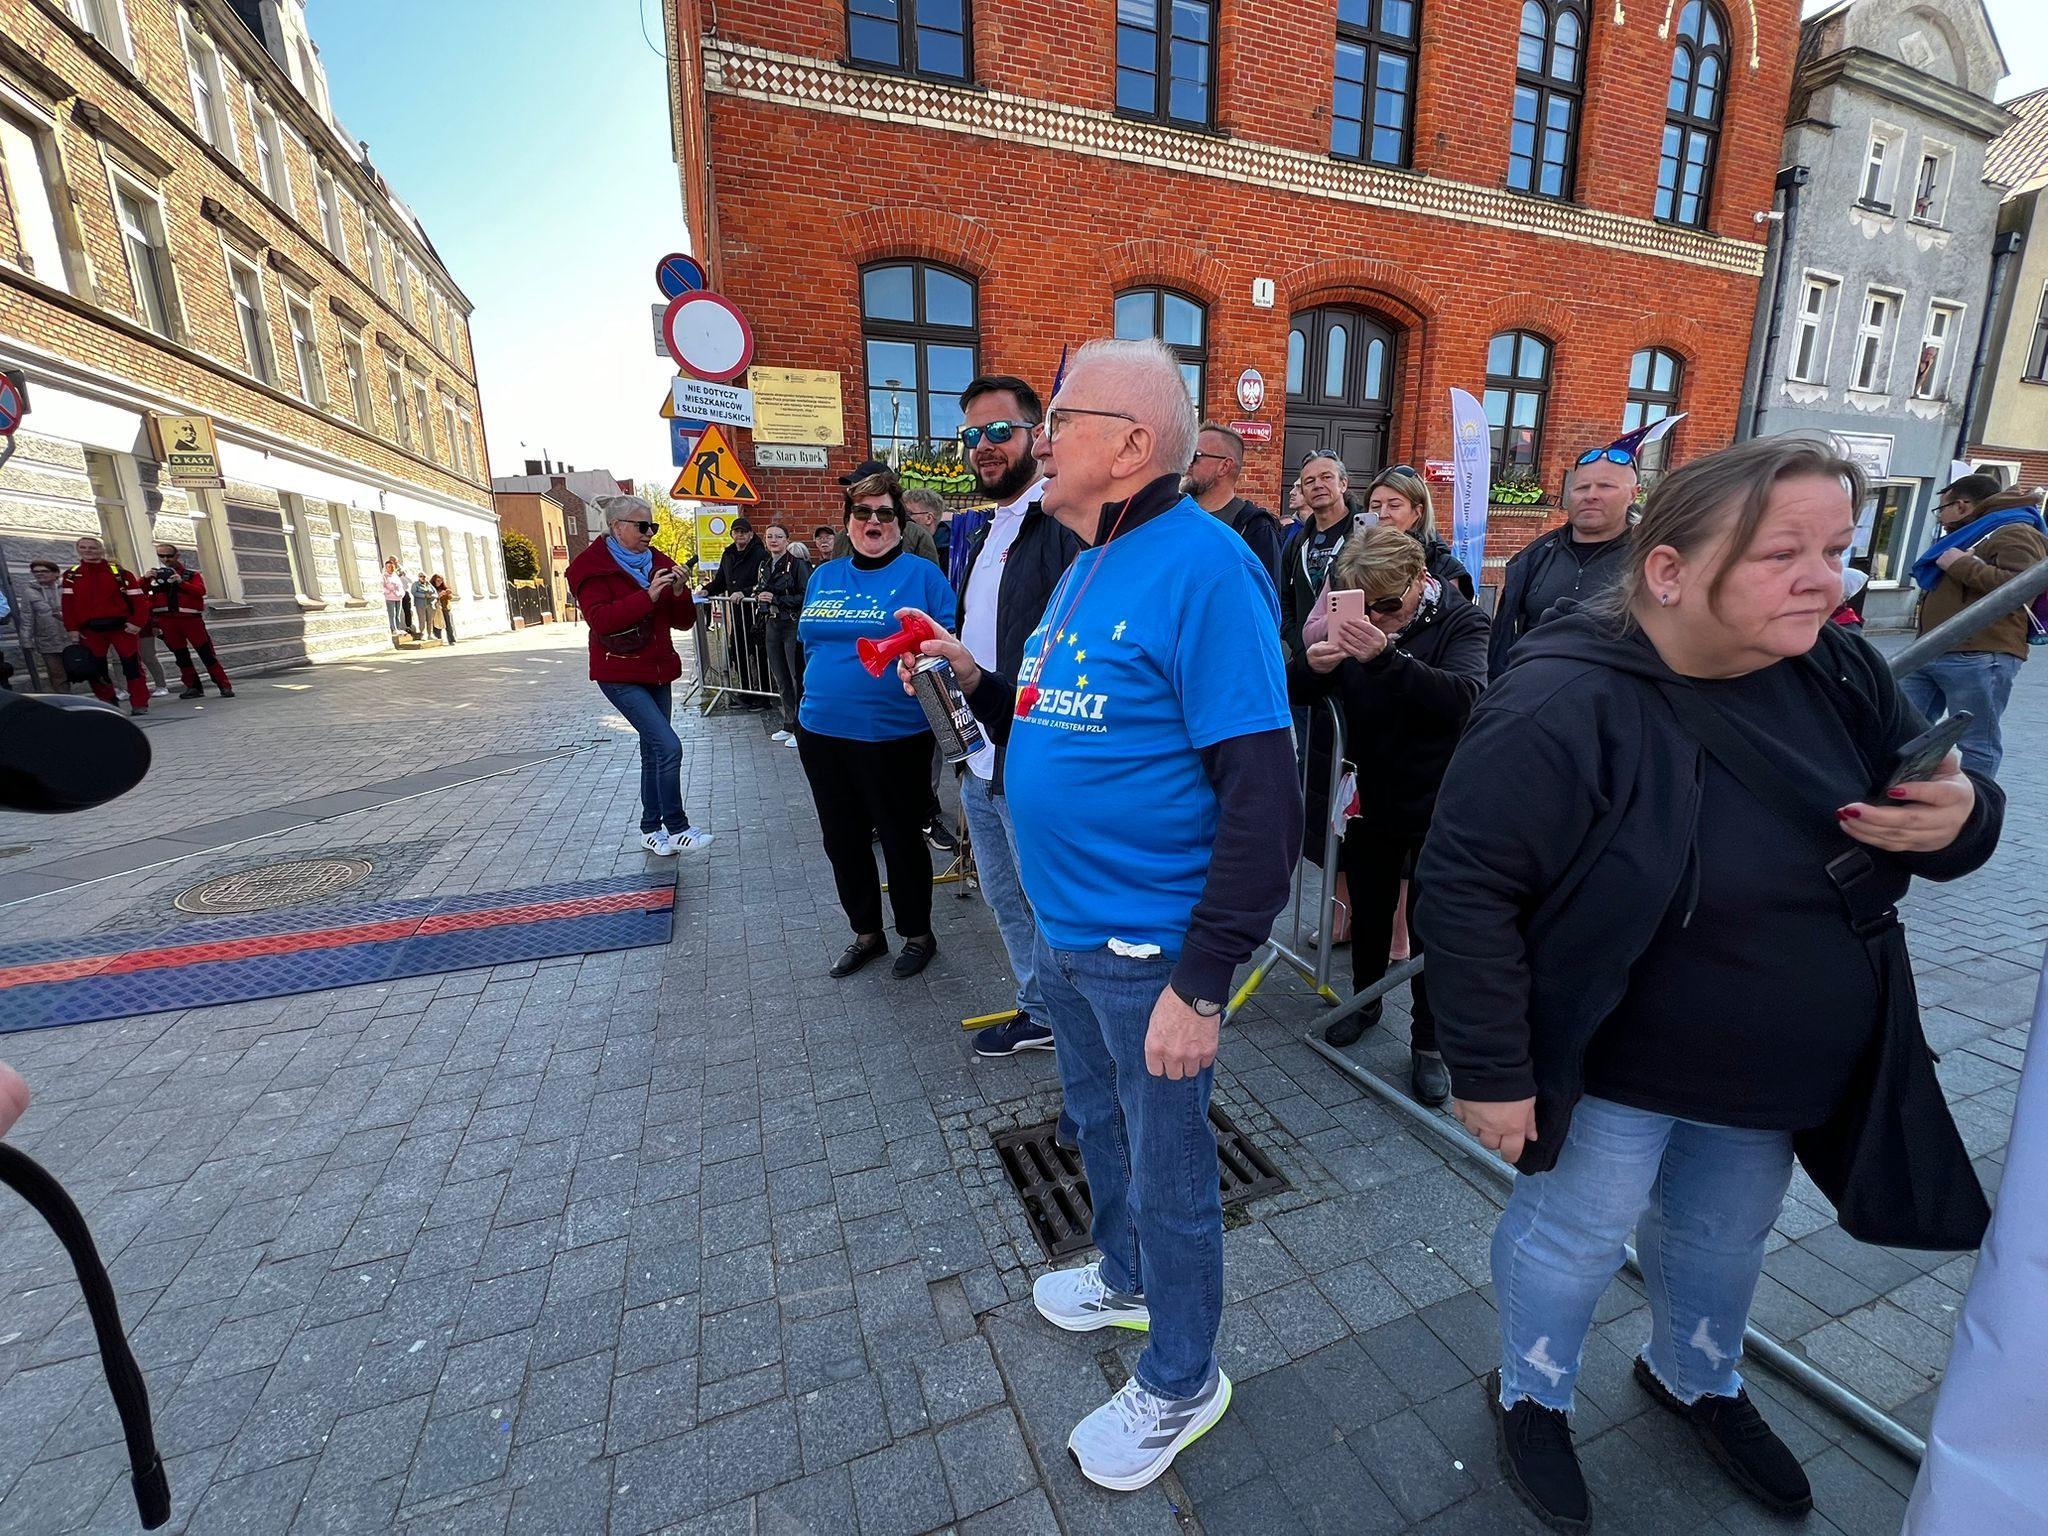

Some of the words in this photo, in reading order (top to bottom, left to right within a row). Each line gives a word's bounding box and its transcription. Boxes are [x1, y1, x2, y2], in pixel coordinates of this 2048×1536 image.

[687, 384, 701, 395] NIE
[703, 387, 739, 400] DOTYCZY
[681, 404, 709, 416] SŁUŻB
[709, 409, 751, 422] MIEJSKICH
[183, 456, 211, 464] KASY
[776, 450, 797, 464] Stary
[799, 450, 823, 465] Rynek
[801, 607, 887, 620] EUROPEJSKI
[1018, 657, 1043, 683] IEG
[1020, 687, 1109, 720] PEJSKI
[1054, 720, 1085, 732] ATESTEM
[1086, 724, 1108, 733] PZLA
